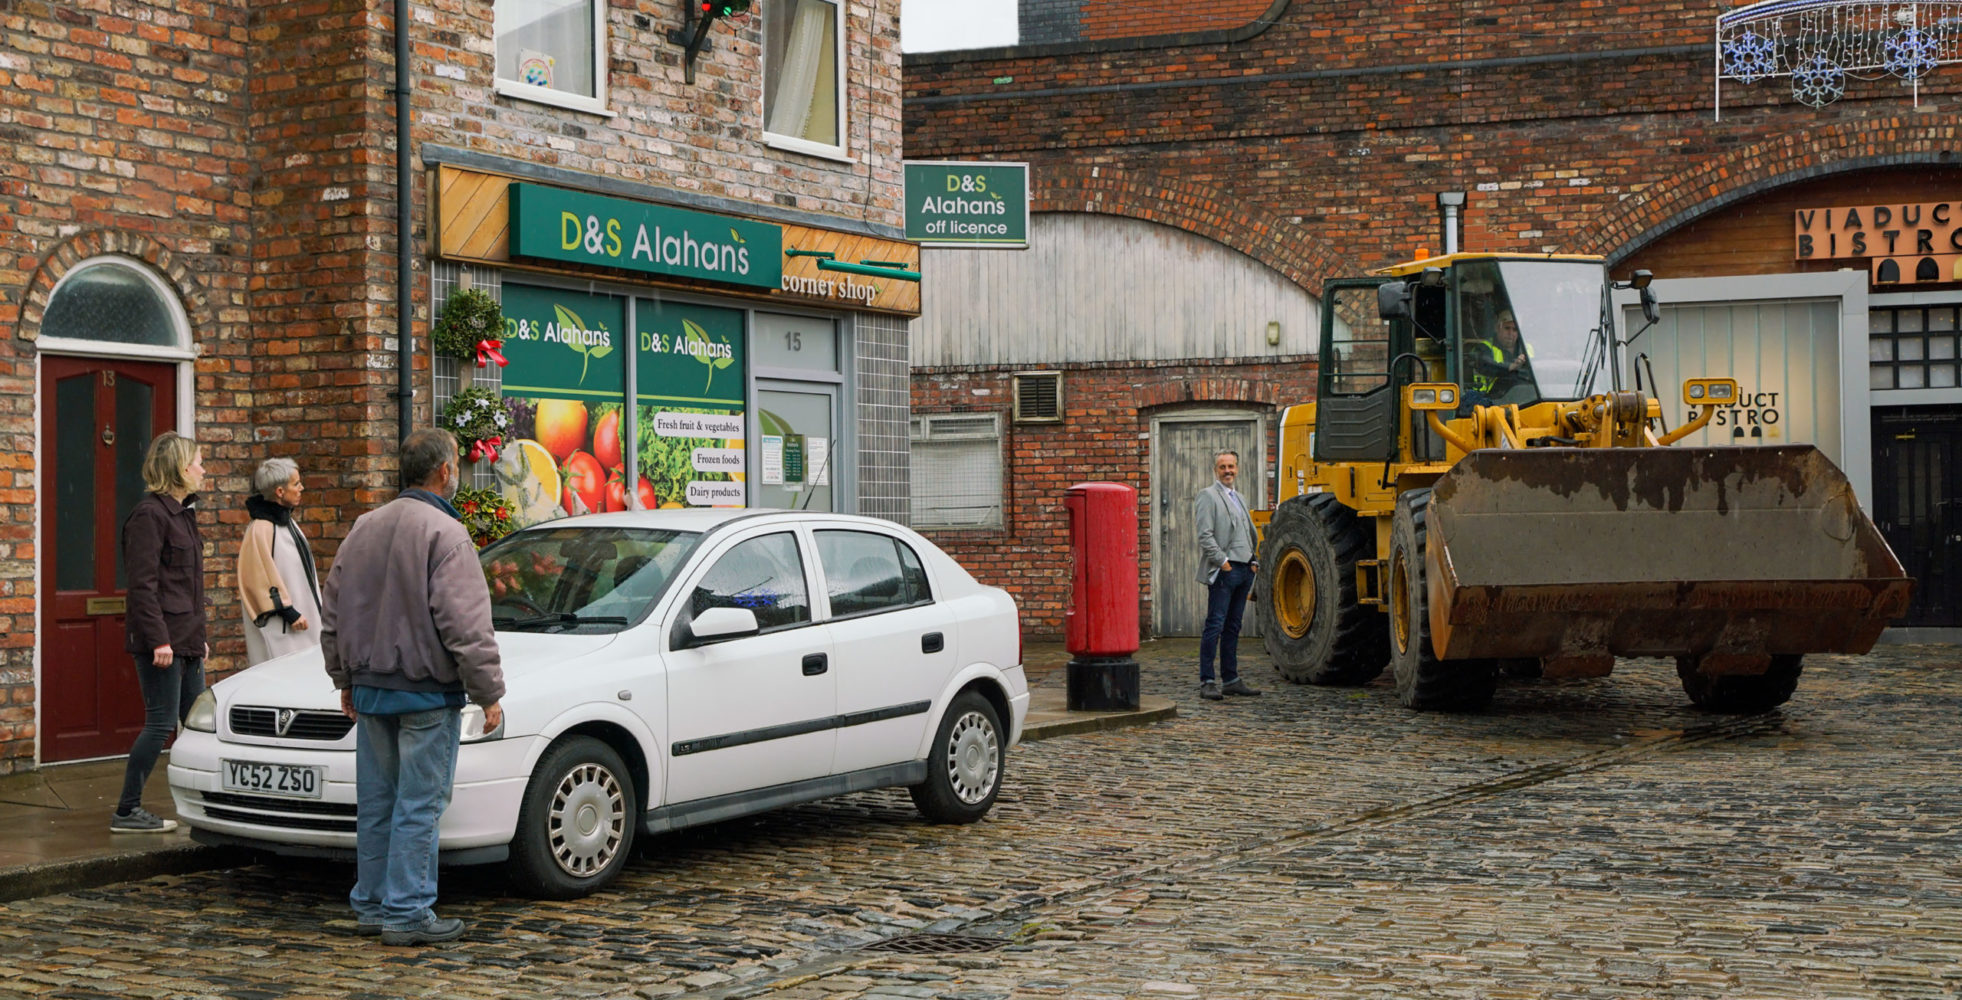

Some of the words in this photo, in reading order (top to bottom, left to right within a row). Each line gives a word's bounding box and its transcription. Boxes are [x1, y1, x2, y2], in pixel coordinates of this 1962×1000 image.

[946, 174, 986, 193] D&S
[925, 220, 946, 234] off
[950, 220, 1008, 234] licence
[1798, 203, 1962, 231] VIADUC
[561, 211, 622, 258] D&S
[781, 274, 835, 297] corner
[838, 275, 876, 307] shop
[506, 317, 540, 341] D&S
[640, 331, 670, 354] D&S
[784, 331, 802, 352] 15
[102, 369, 115, 387] 13
[657, 418, 678, 430] Fresh
[680, 419, 695, 430] fruit
[696, 420, 703, 431] &
[705, 422, 740, 434] vegetables
[1687, 408, 1779, 426] BSTRO
[697, 453, 721, 464] Frozen
[722, 454, 740, 465] foods
[690, 486, 710, 499] Dairy
[711, 487, 741, 499] products
[229, 761, 272, 789] YC52
[278, 765, 314, 793] ZSO
